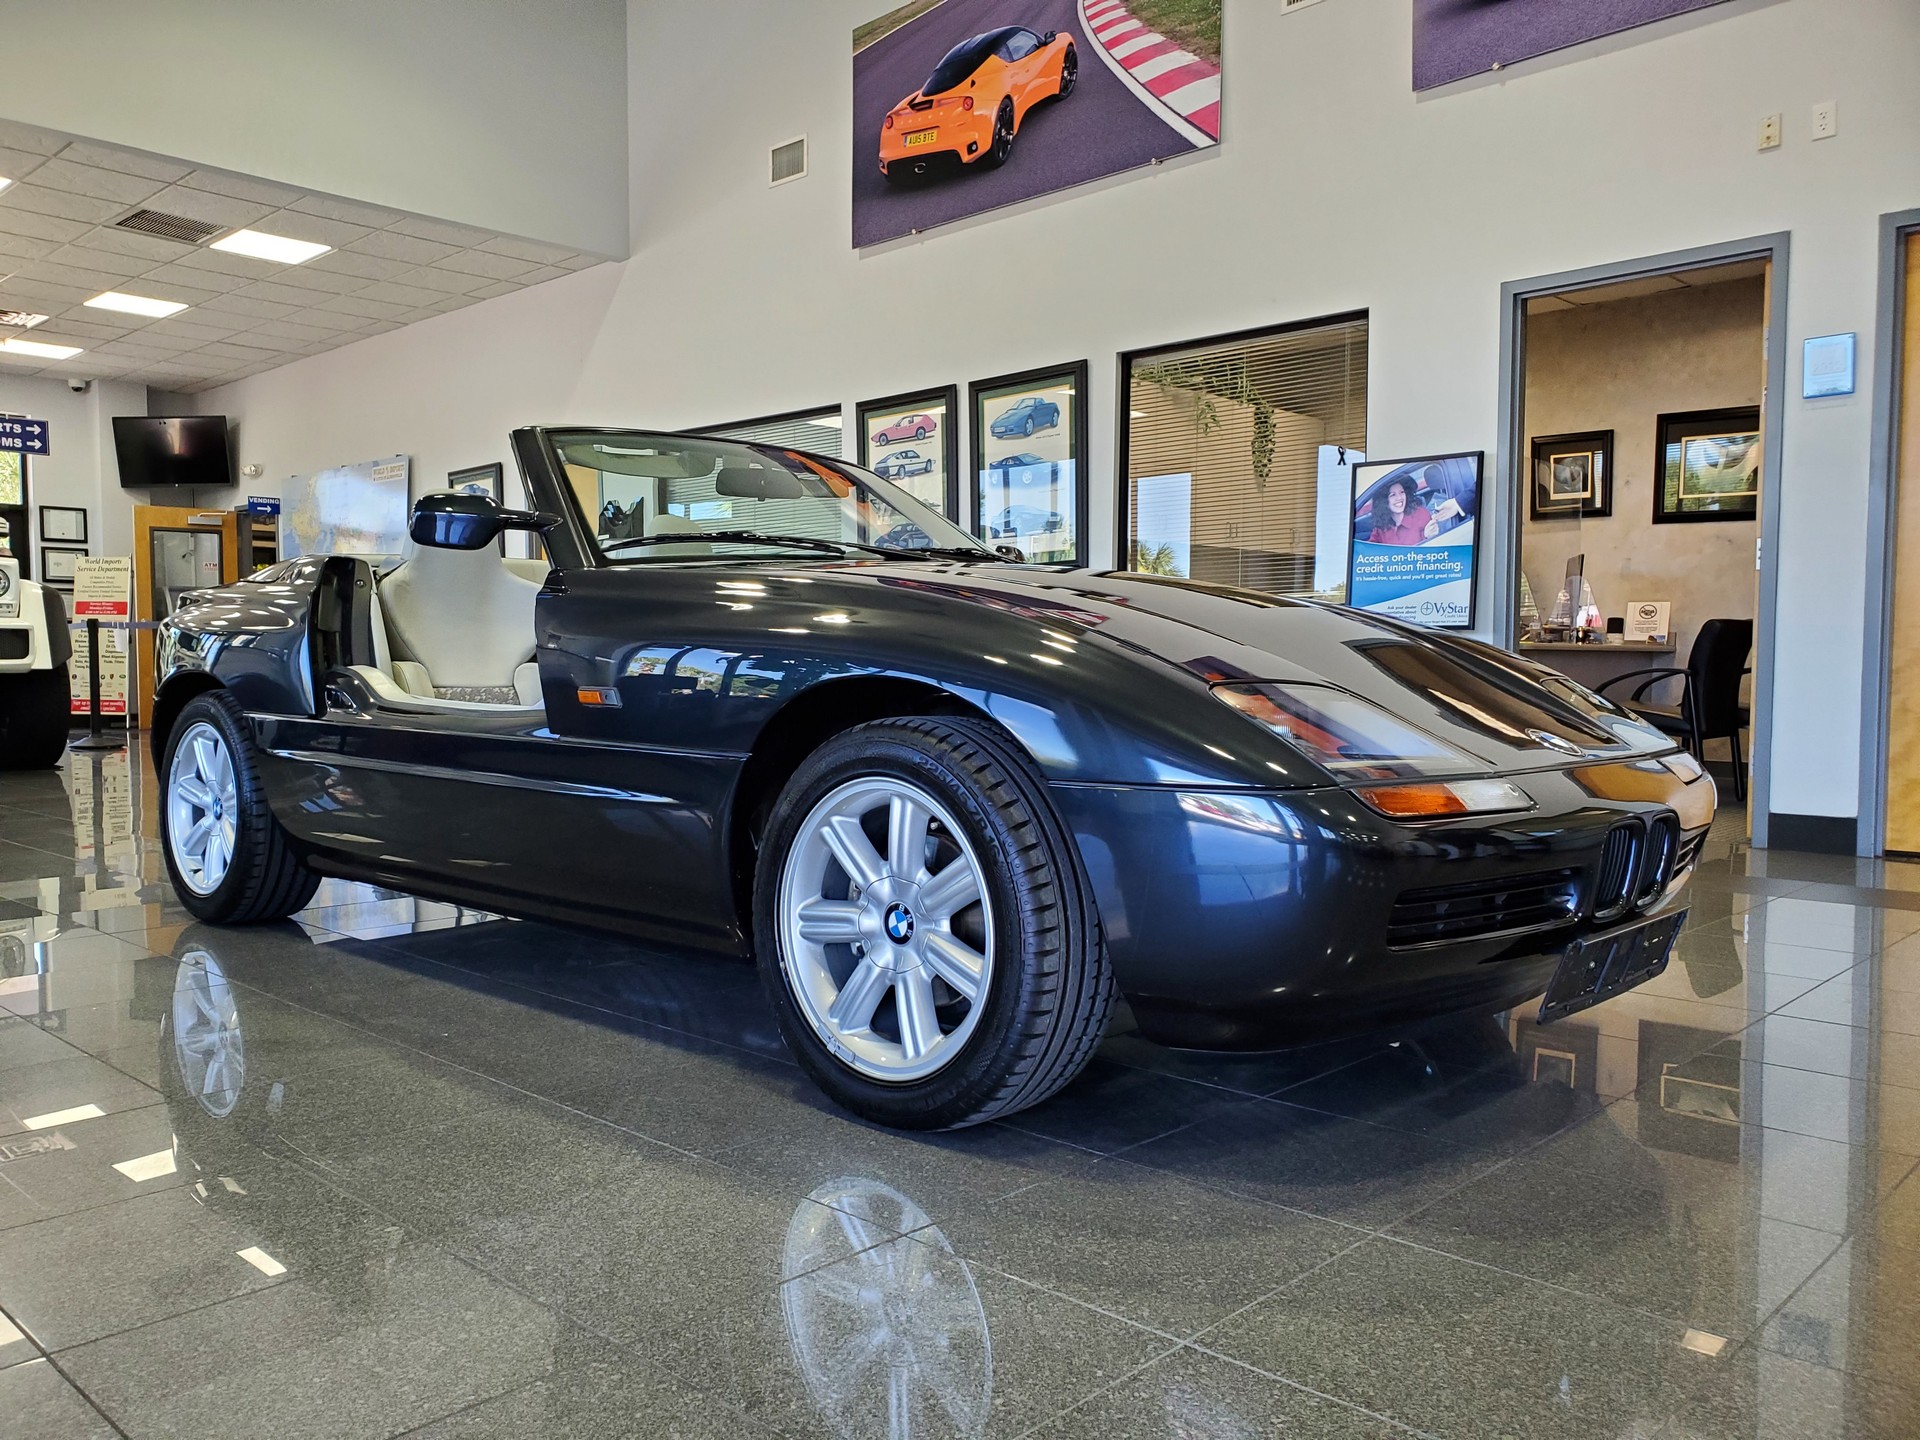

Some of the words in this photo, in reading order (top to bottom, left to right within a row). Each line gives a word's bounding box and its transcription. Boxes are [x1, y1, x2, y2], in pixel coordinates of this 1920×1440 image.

[0, 437, 23, 448] MS
[248, 496, 280, 504] VENDING
[101, 558, 122, 566] Imports
[1356, 554, 1389, 564] Access
[1391, 551, 1449, 562] on-the-spot
[1356, 563, 1384, 573] credit
[1386, 563, 1414, 572] union
[1416, 561, 1464, 572] financing.
[1433, 601, 1468, 617] VyStar
